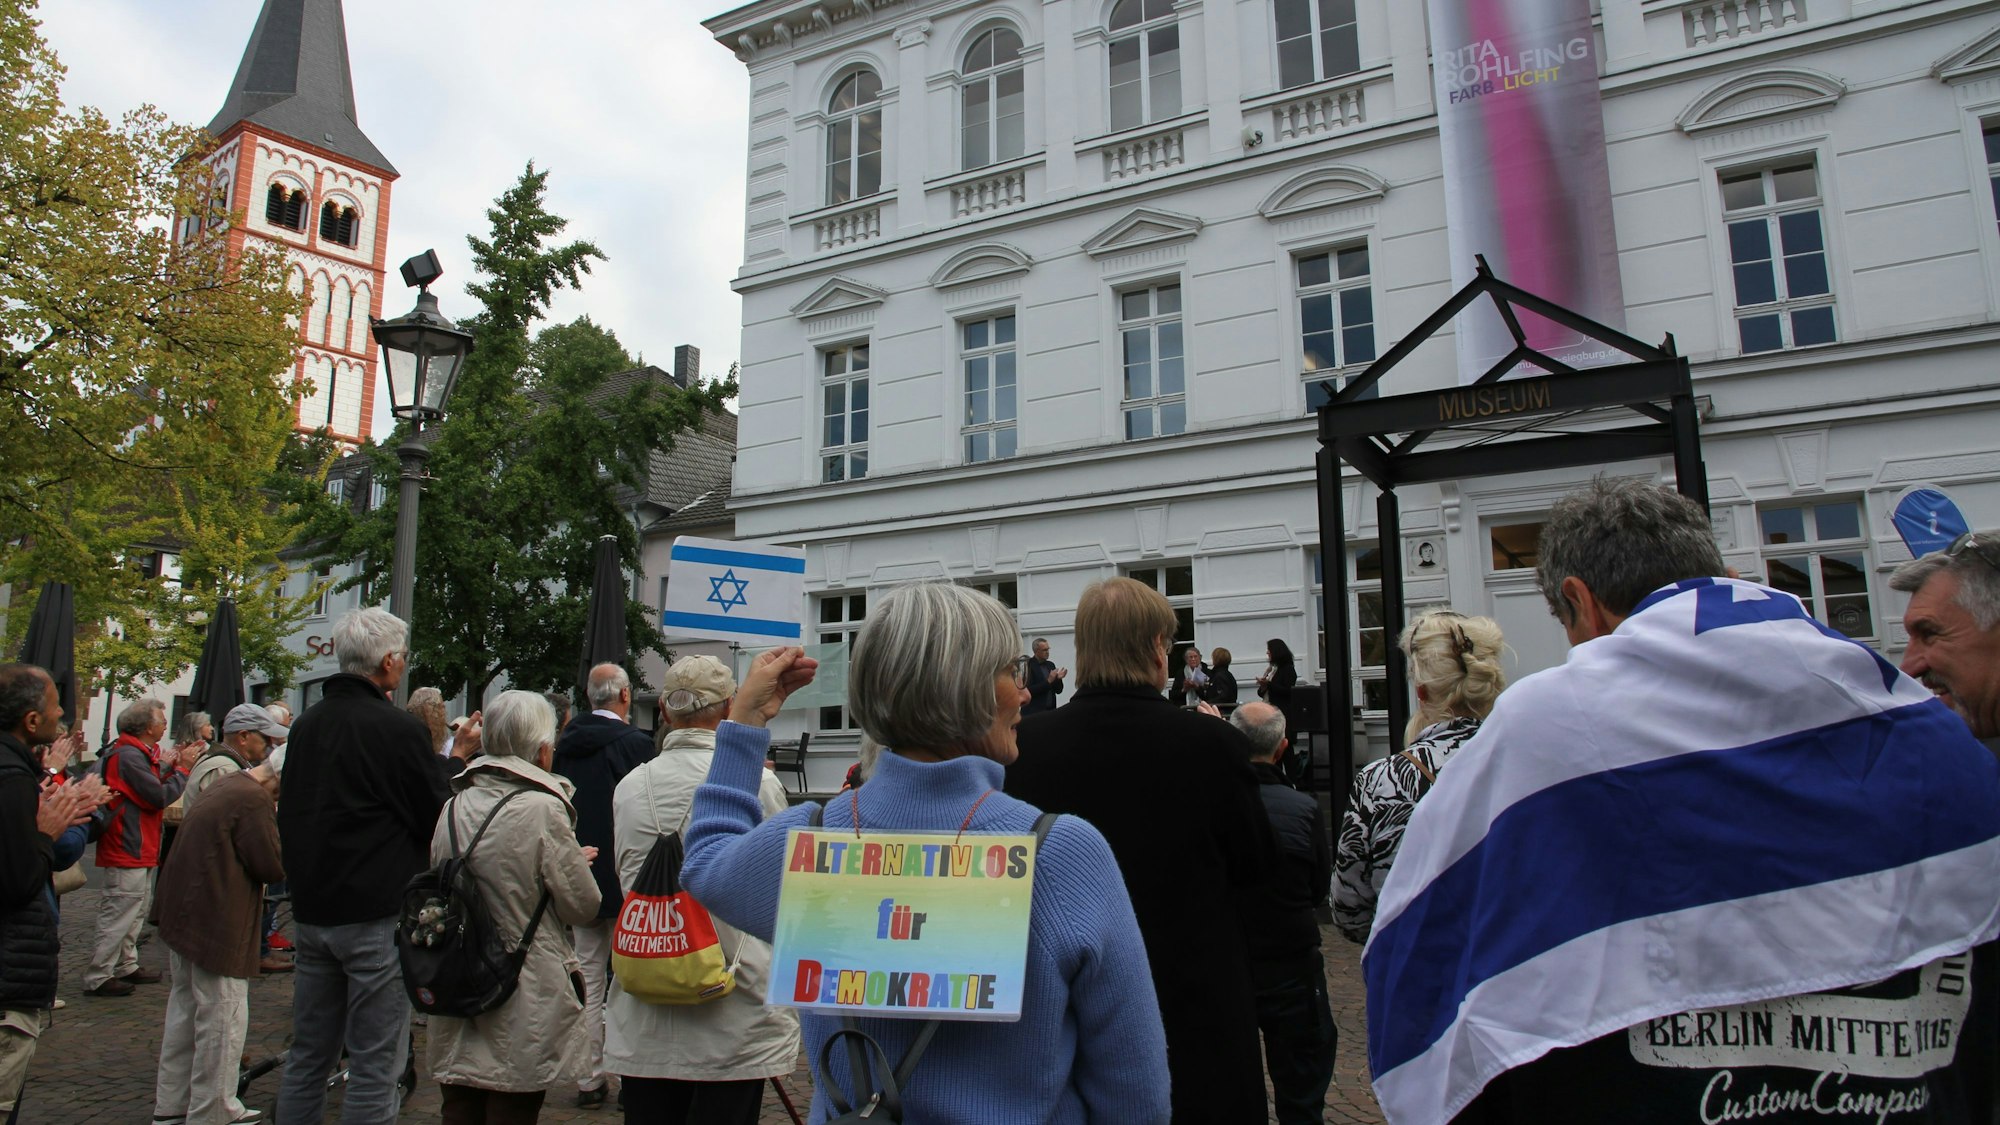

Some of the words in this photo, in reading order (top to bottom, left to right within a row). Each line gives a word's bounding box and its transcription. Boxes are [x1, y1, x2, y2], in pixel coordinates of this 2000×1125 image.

[1440, 39, 1500, 70] RITA
[1441, 37, 1588, 89] ROHLFING
[1438, 381, 1551, 421] MUSEUM
[789, 832, 1028, 878] ALTERNATIVLOS
[621, 898, 685, 933] GENUS
[877, 898, 927, 940] für
[617, 931, 689, 954] WELTMEISTR
[793, 959, 997, 1009] DEMOKRATIE
[1646, 1010, 1774, 1048] BERLIN
[1791, 1014, 1913, 1058] MITTE
